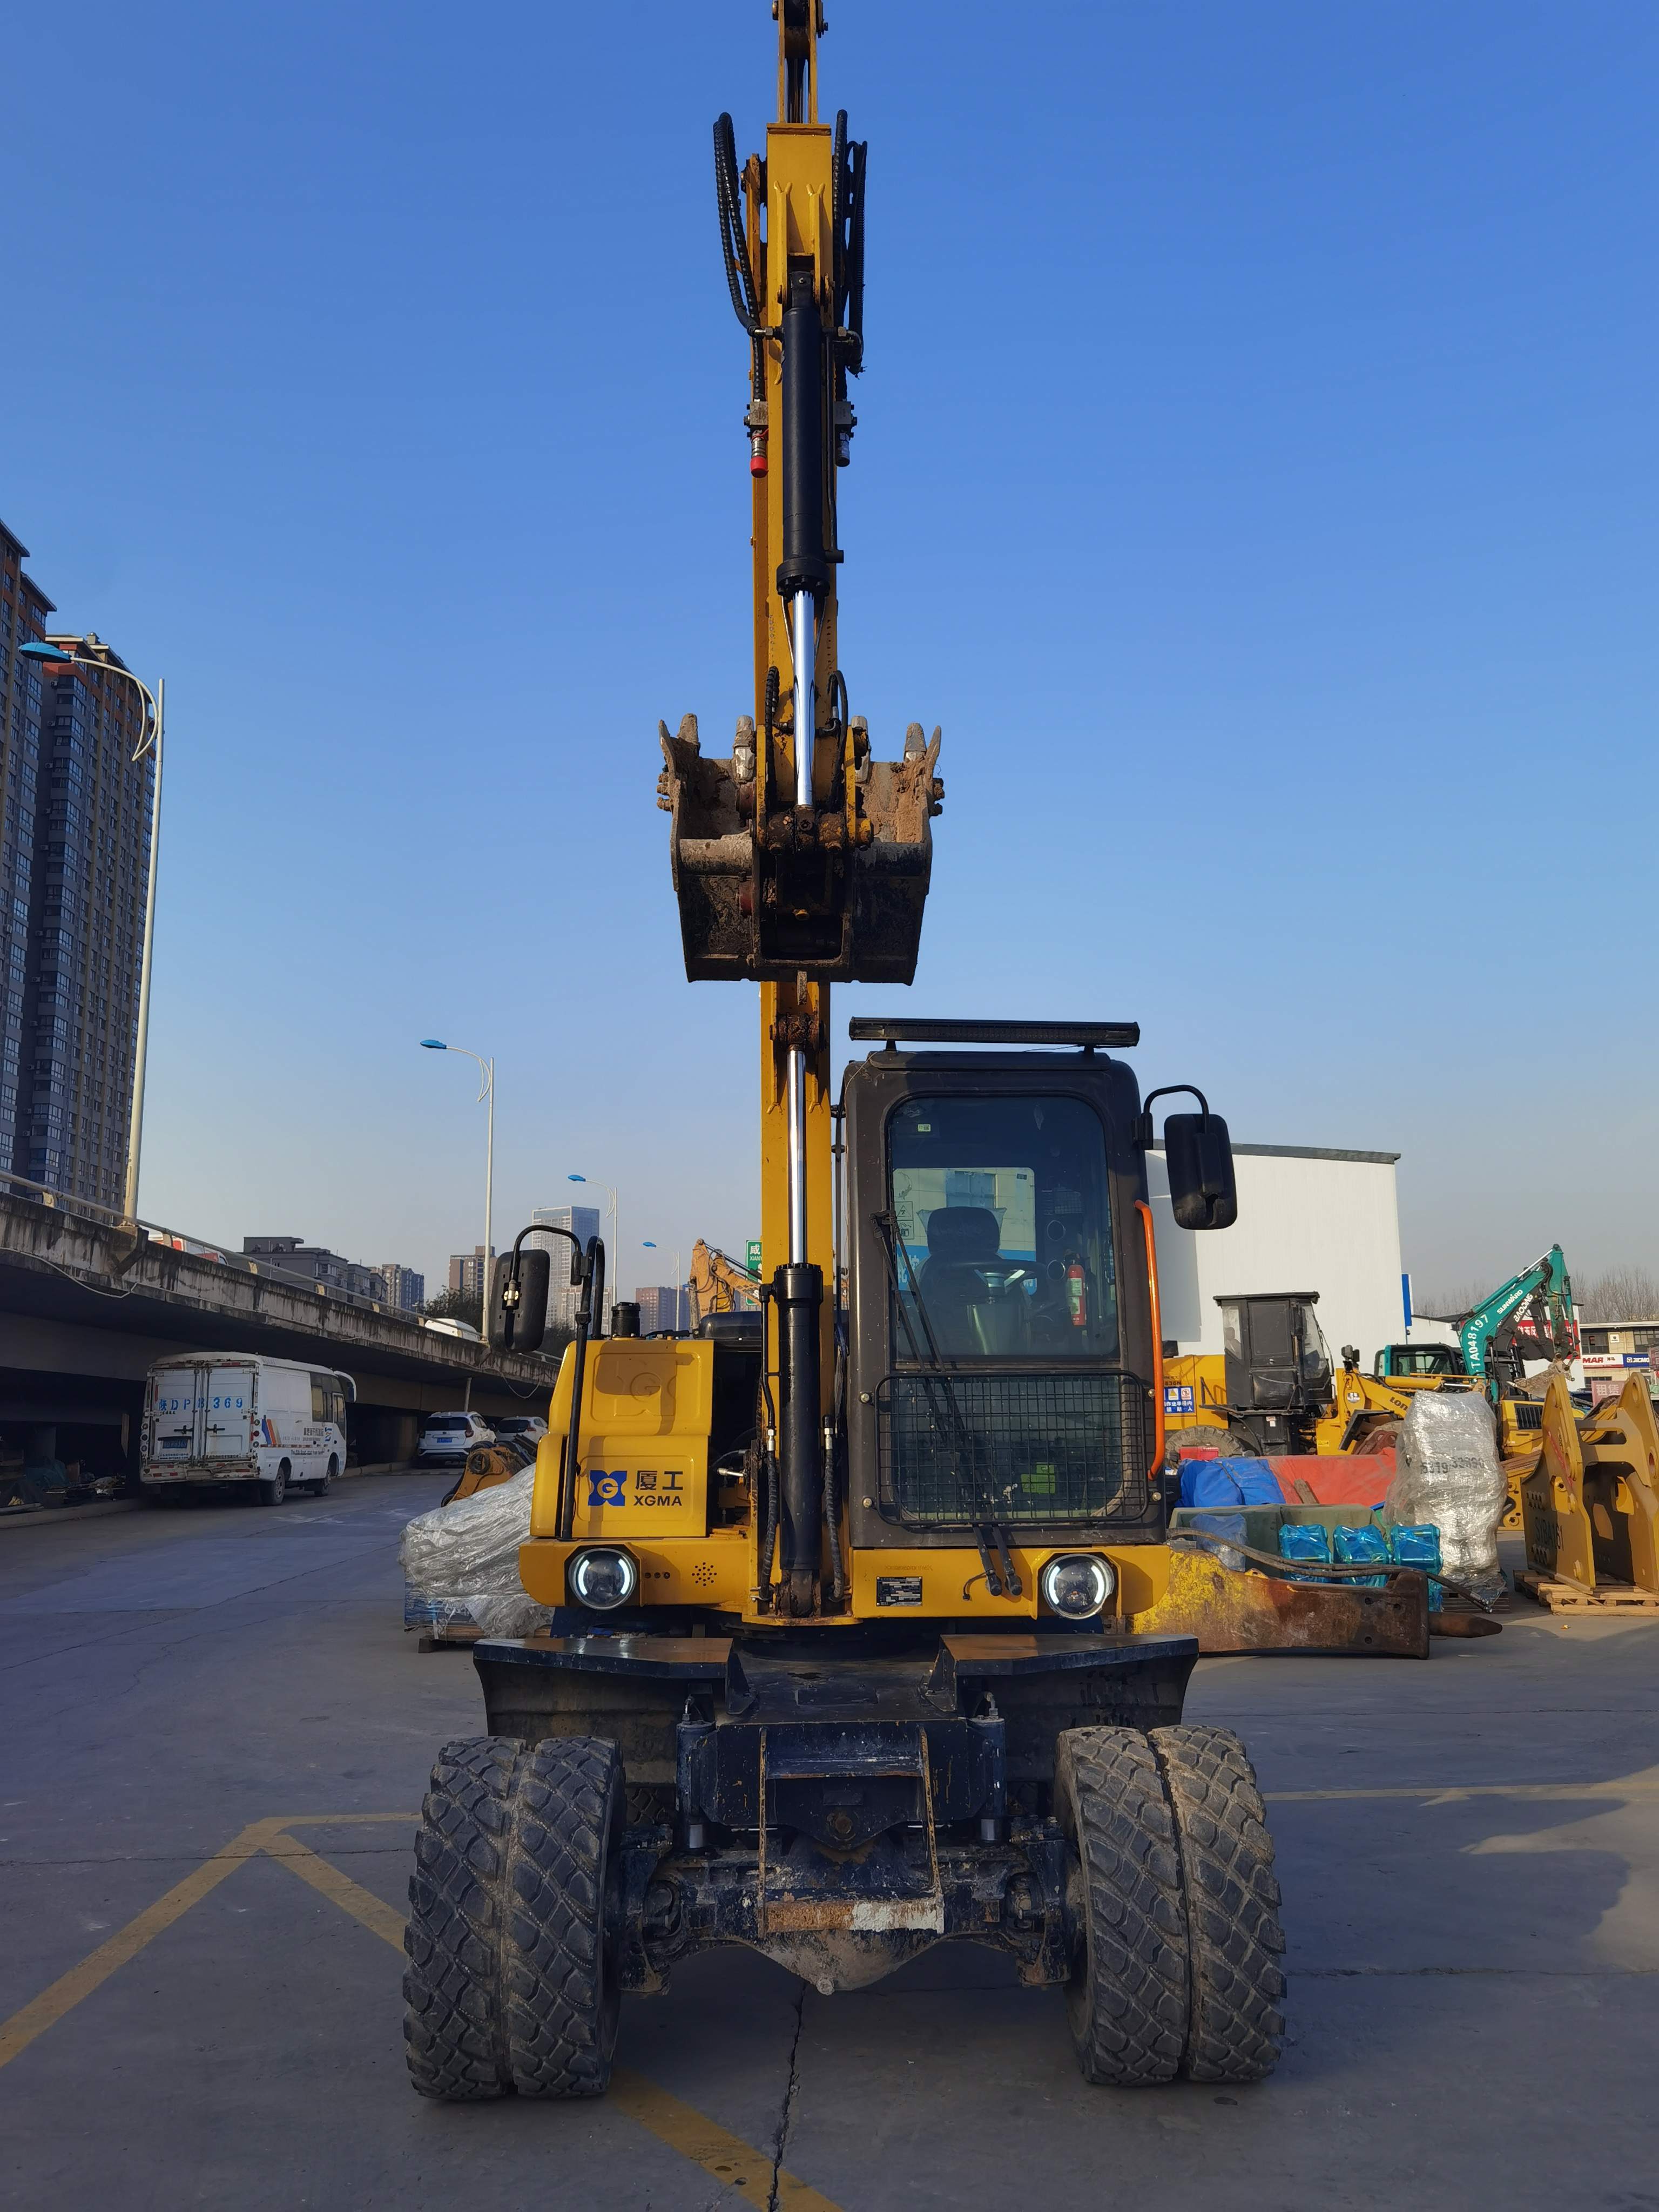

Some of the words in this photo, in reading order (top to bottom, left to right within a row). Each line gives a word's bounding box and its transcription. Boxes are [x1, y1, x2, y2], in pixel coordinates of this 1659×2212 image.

[750, 1244, 760, 1255] 咸
[1497, 1289, 1523, 1314] SUNWARD
[1467, 1314, 1488, 1368] TA048197
[635, 1470, 683, 1491] 厦工
[633, 1495, 683, 1506] XGMA
